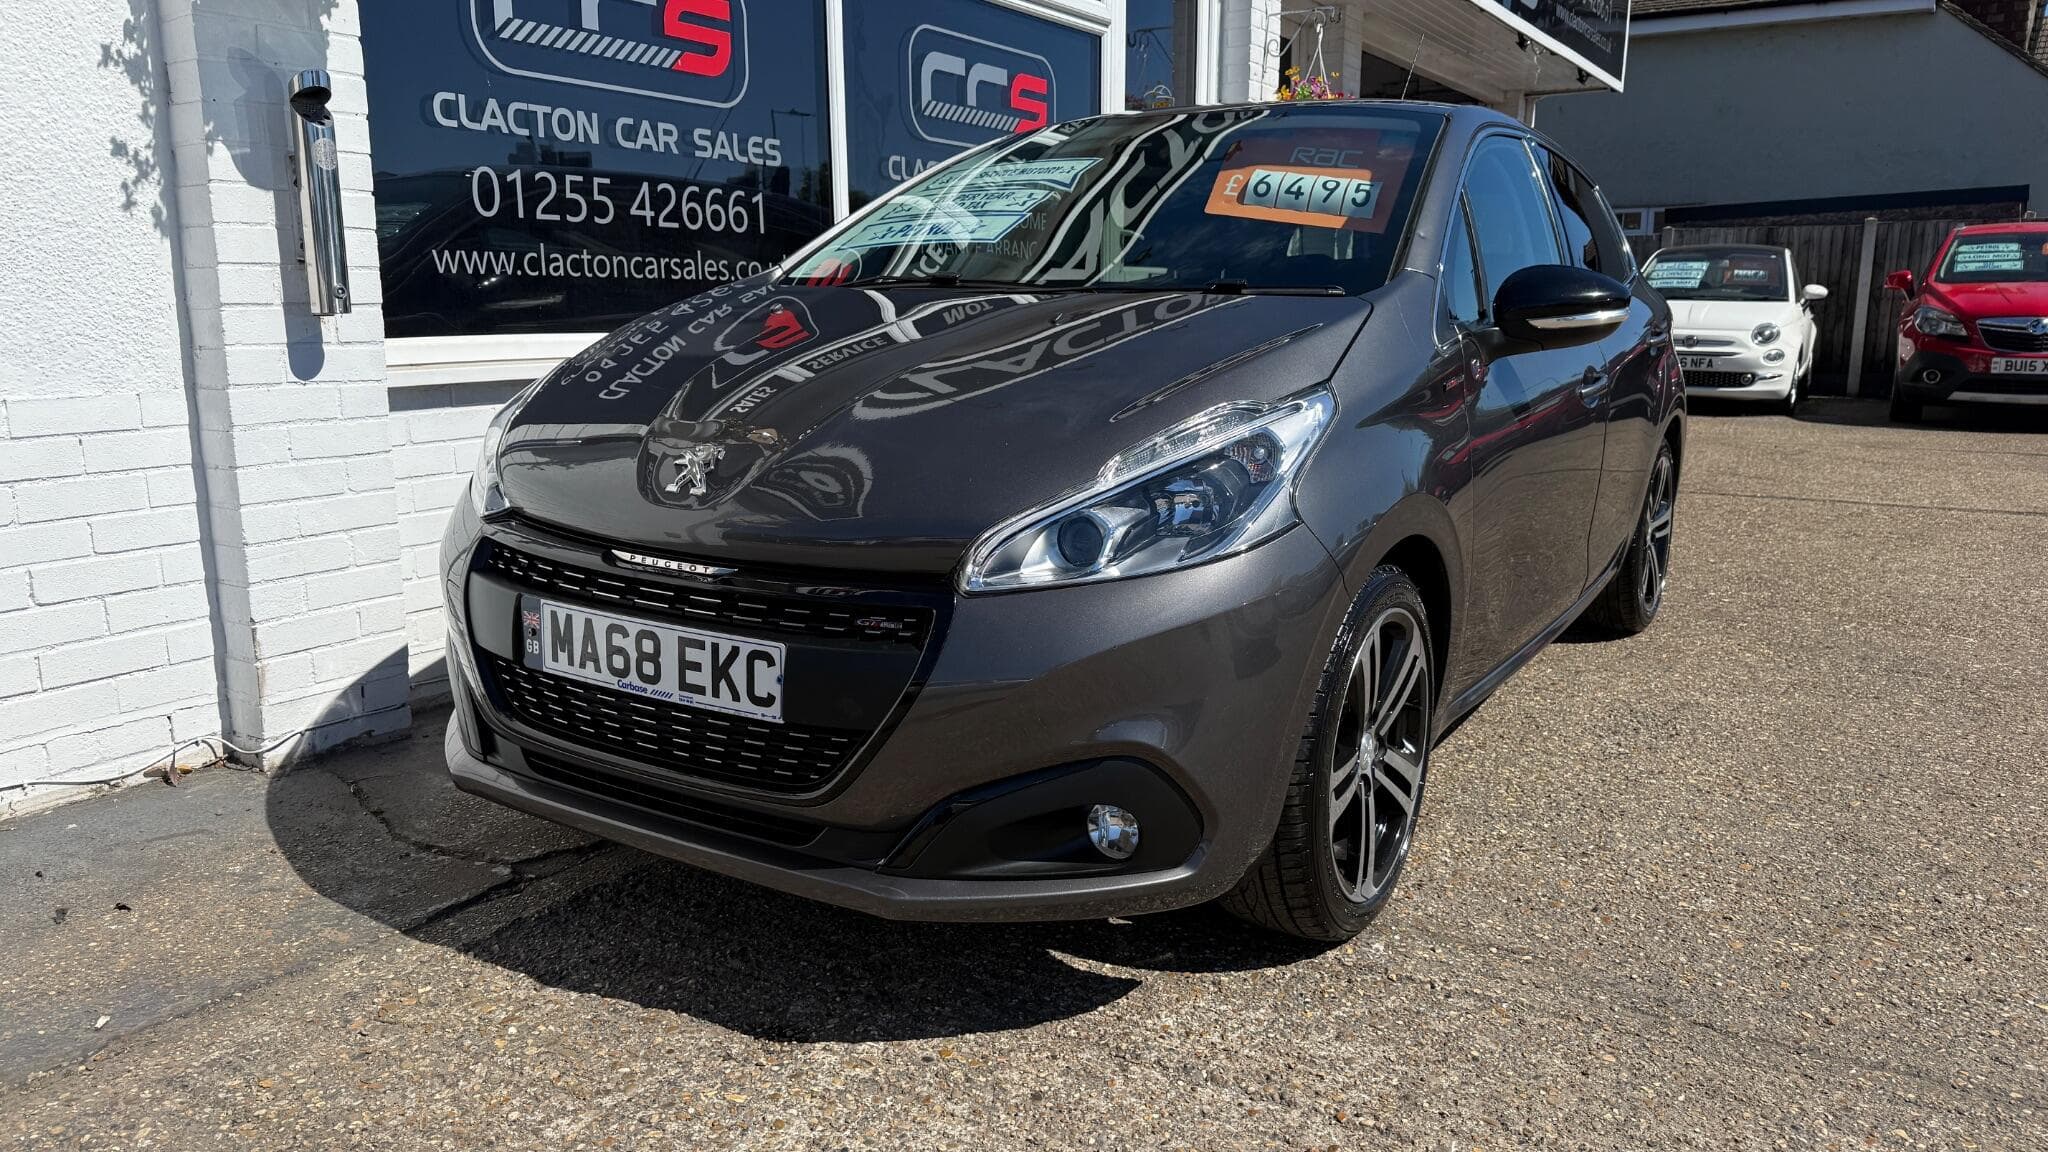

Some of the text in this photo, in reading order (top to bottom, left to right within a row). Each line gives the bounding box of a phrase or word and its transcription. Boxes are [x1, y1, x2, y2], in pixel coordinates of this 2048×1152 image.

[432, 91, 782, 167] CLACTON CAR SALES
[472, 166, 767, 235] 01255 426661
[432, 242, 787, 282] www.clactoncarsales.co
[1690, 358, 1714, 369] NFA
[2004, 360, 2038, 372] BU15
[629, 554, 711, 573] PEUGEOT
[526, 638, 539, 655] GB
[550, 609, 777, 708] MA68 EKC
[617, 679, 648, 694] Carbase
